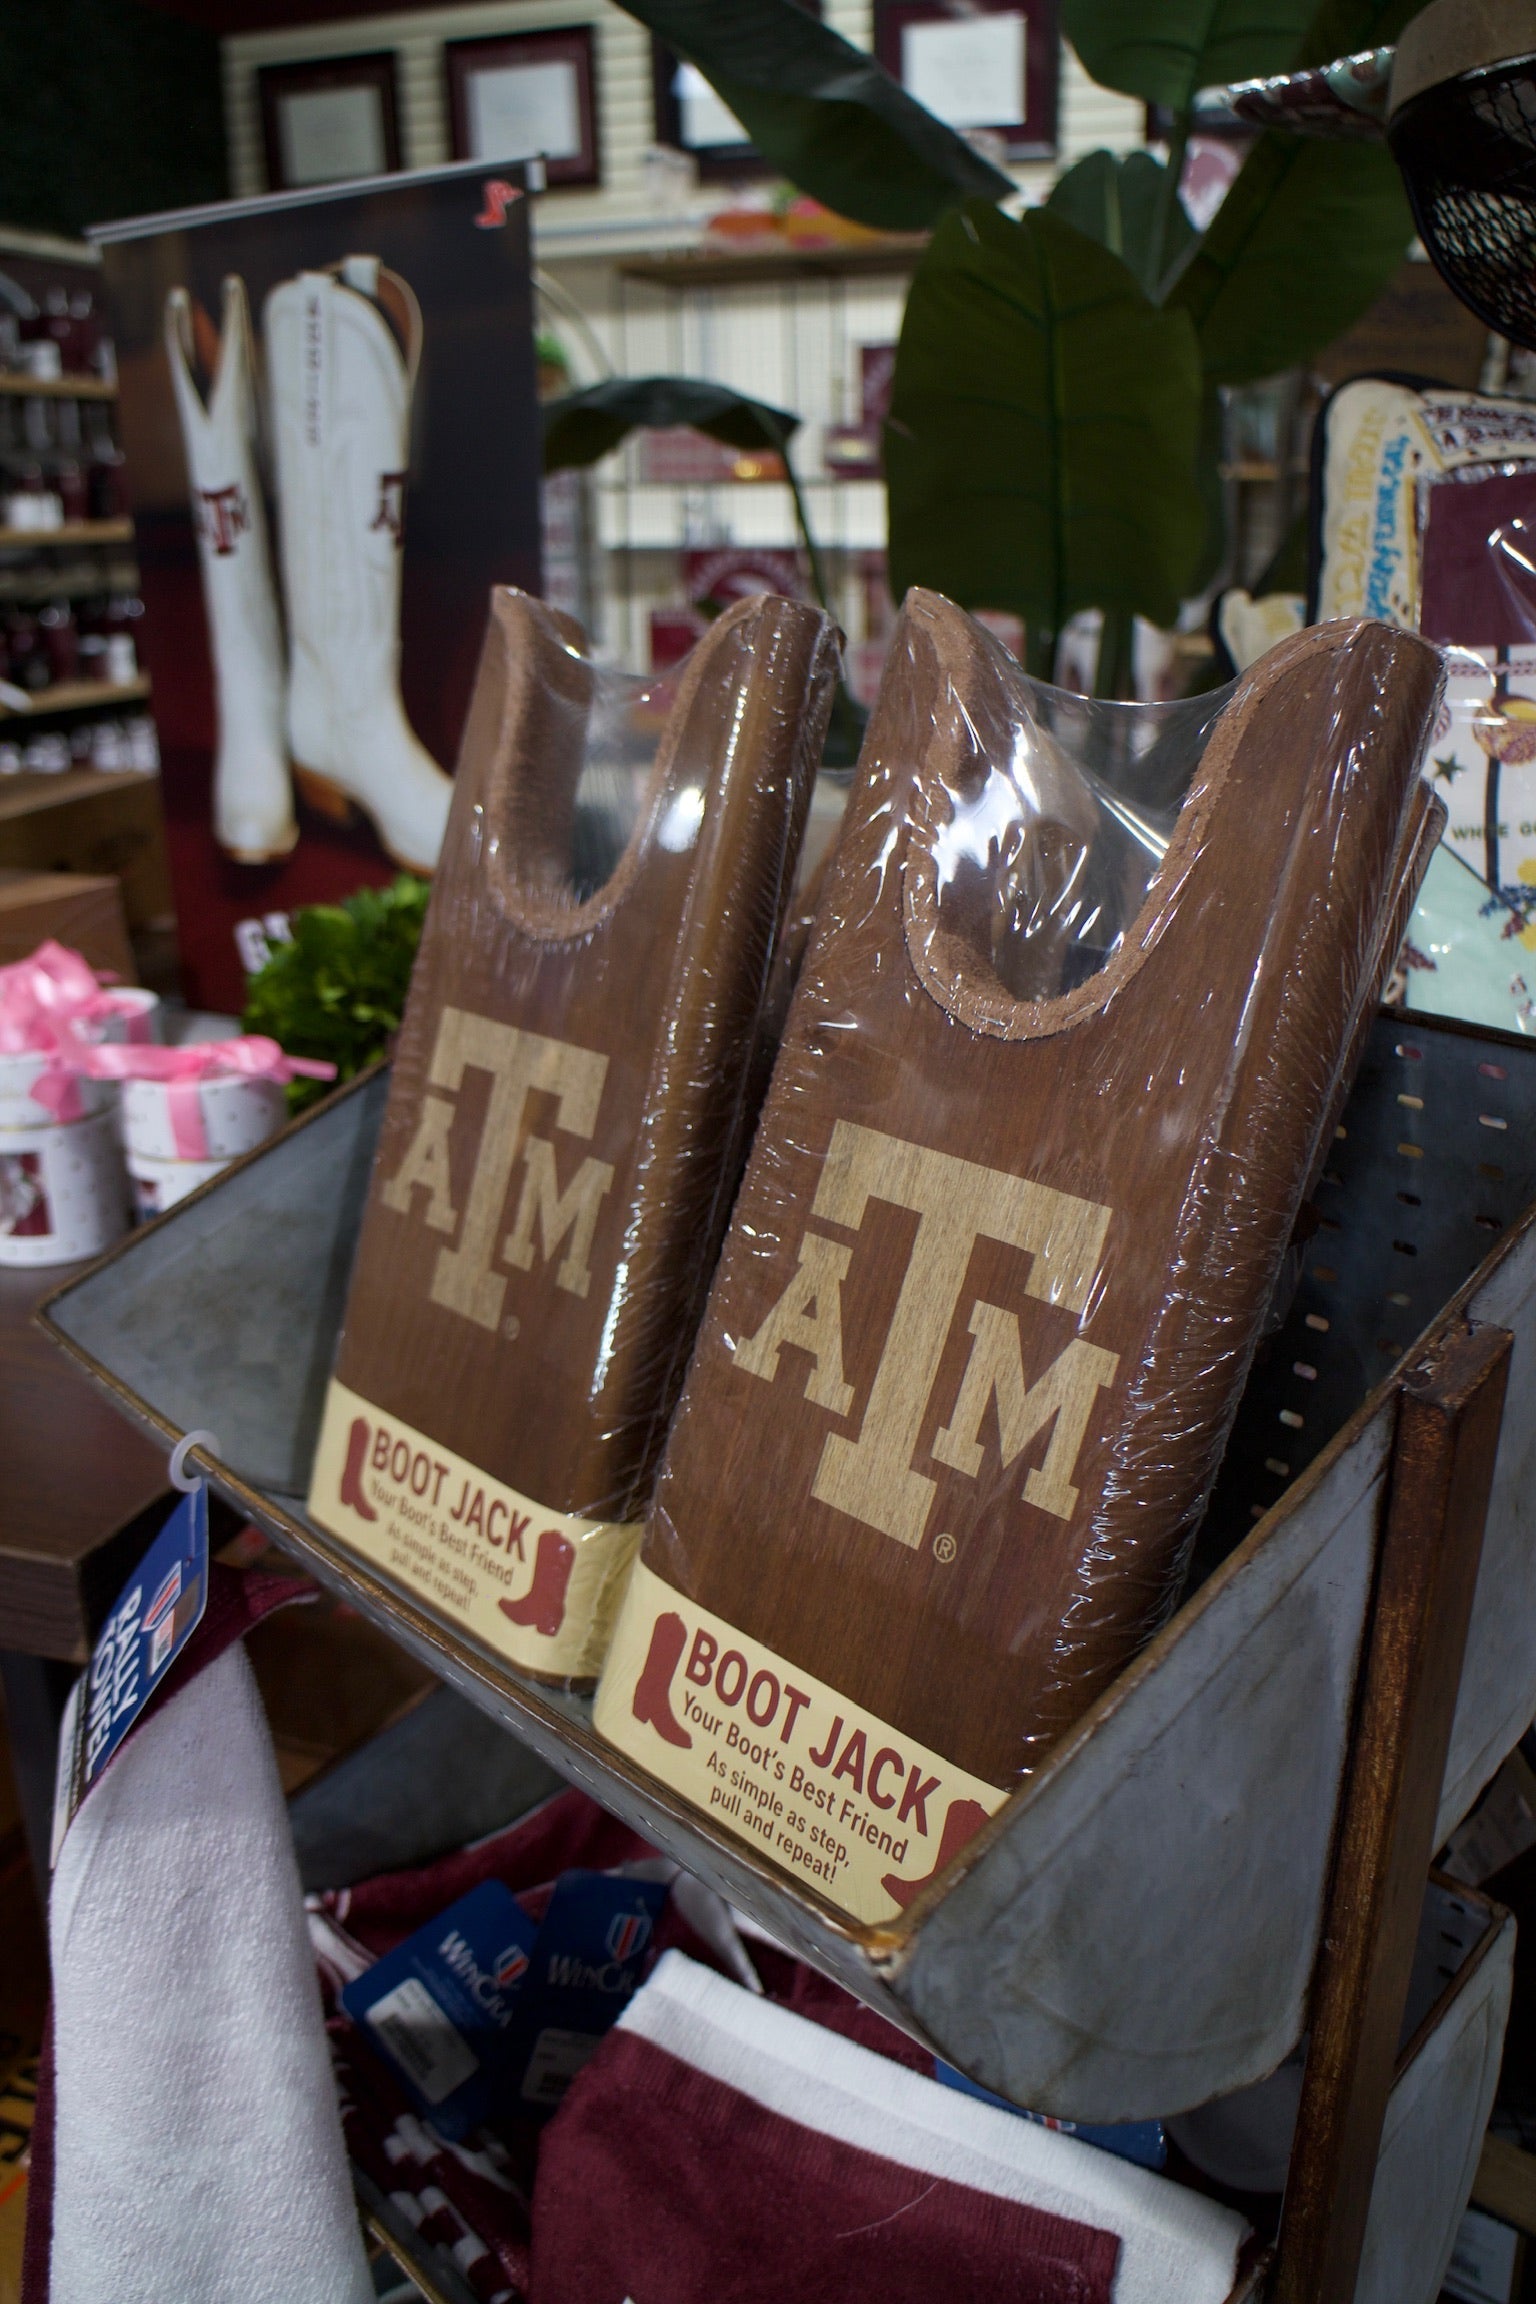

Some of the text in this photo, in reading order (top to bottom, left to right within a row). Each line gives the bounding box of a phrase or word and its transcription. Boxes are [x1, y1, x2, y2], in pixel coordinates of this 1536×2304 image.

[371, 1479, 514, 1586] Your Boot's Best Friend
[372, 1427, 532, 1562] BOOT JACK
[388, 1521, 403, 1539] As
[403, 1531, 437, 1571] simple
[439, 1557, 452, 1574] as
[390, 1548, 471, 1609] pull and repeat!
[86, 1615, 117, 1782] TOWEL
[112, 1584, 142, 1724] RALLY
[683, 1690, 910, 1864] Your Boot's Best Friend
[685, 1627, 942, 1837] BOOT JACK
[707, 1750, 851, 1868] As simple as step,
[711, 1784, 838, 1885] pull and repeat!
